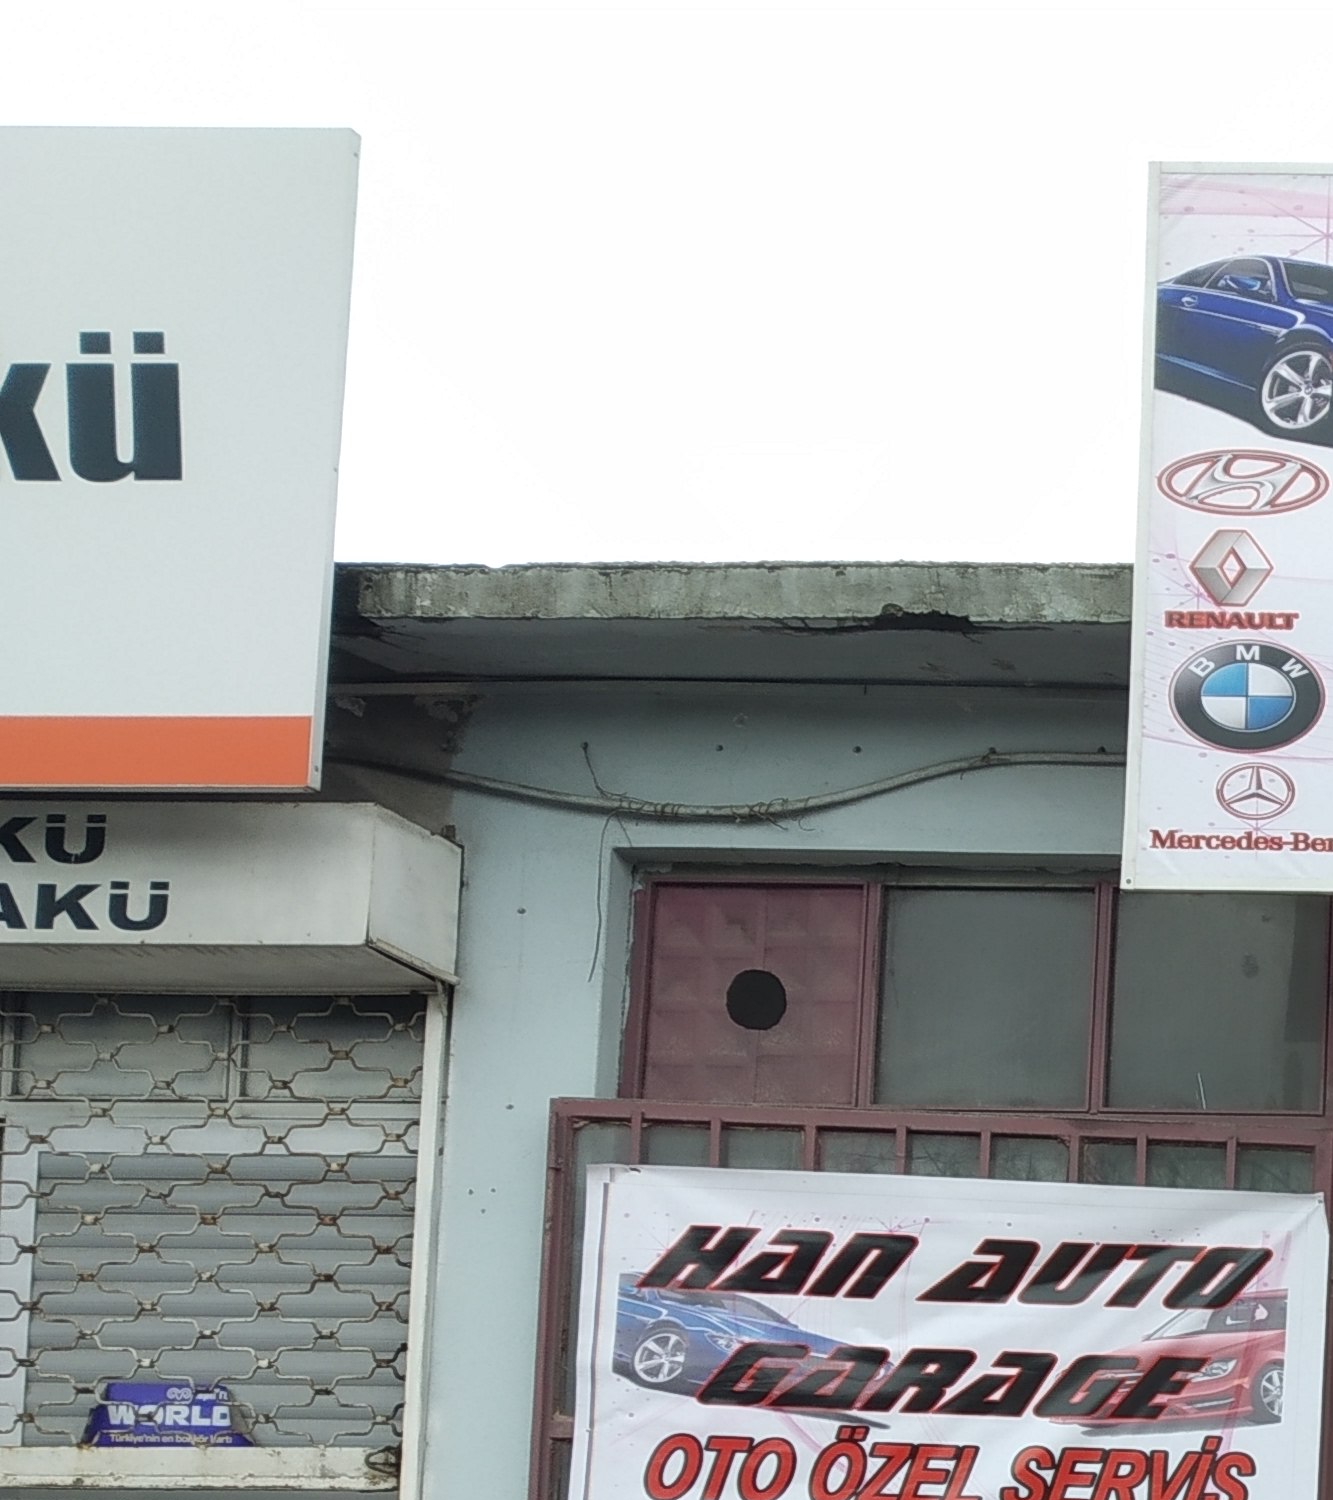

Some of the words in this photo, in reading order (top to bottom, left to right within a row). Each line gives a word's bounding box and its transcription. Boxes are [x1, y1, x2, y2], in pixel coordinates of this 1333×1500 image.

[1164, 610, 1299, 631] RENAULT
[1188, 644, 1309, 680] BMW
[696, 1342, 1211, 1419] GARAGE
[108, 1405, 231, 1426] WORLD
